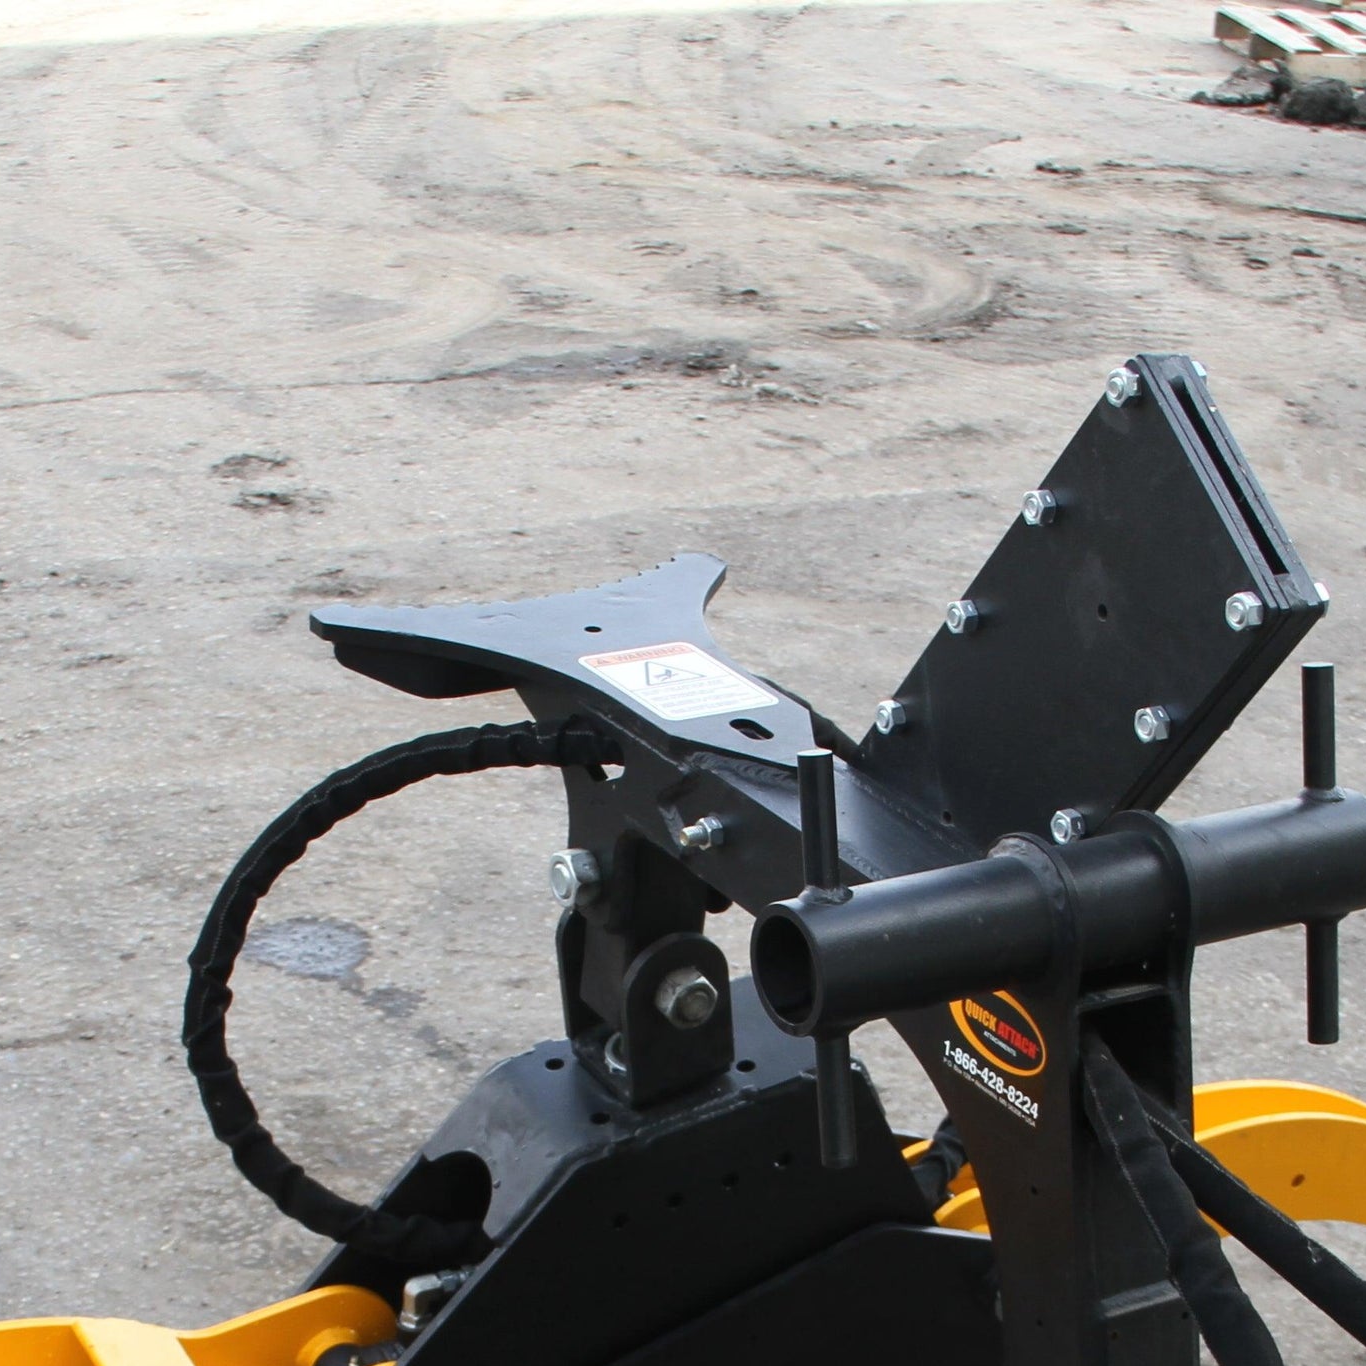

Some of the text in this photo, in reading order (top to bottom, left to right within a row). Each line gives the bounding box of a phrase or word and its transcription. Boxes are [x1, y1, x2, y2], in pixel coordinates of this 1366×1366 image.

[965, 998, 1038, 1059] QUICK ATTACH
[943, 1040, 1039, 1119] 1-866-428-8224
